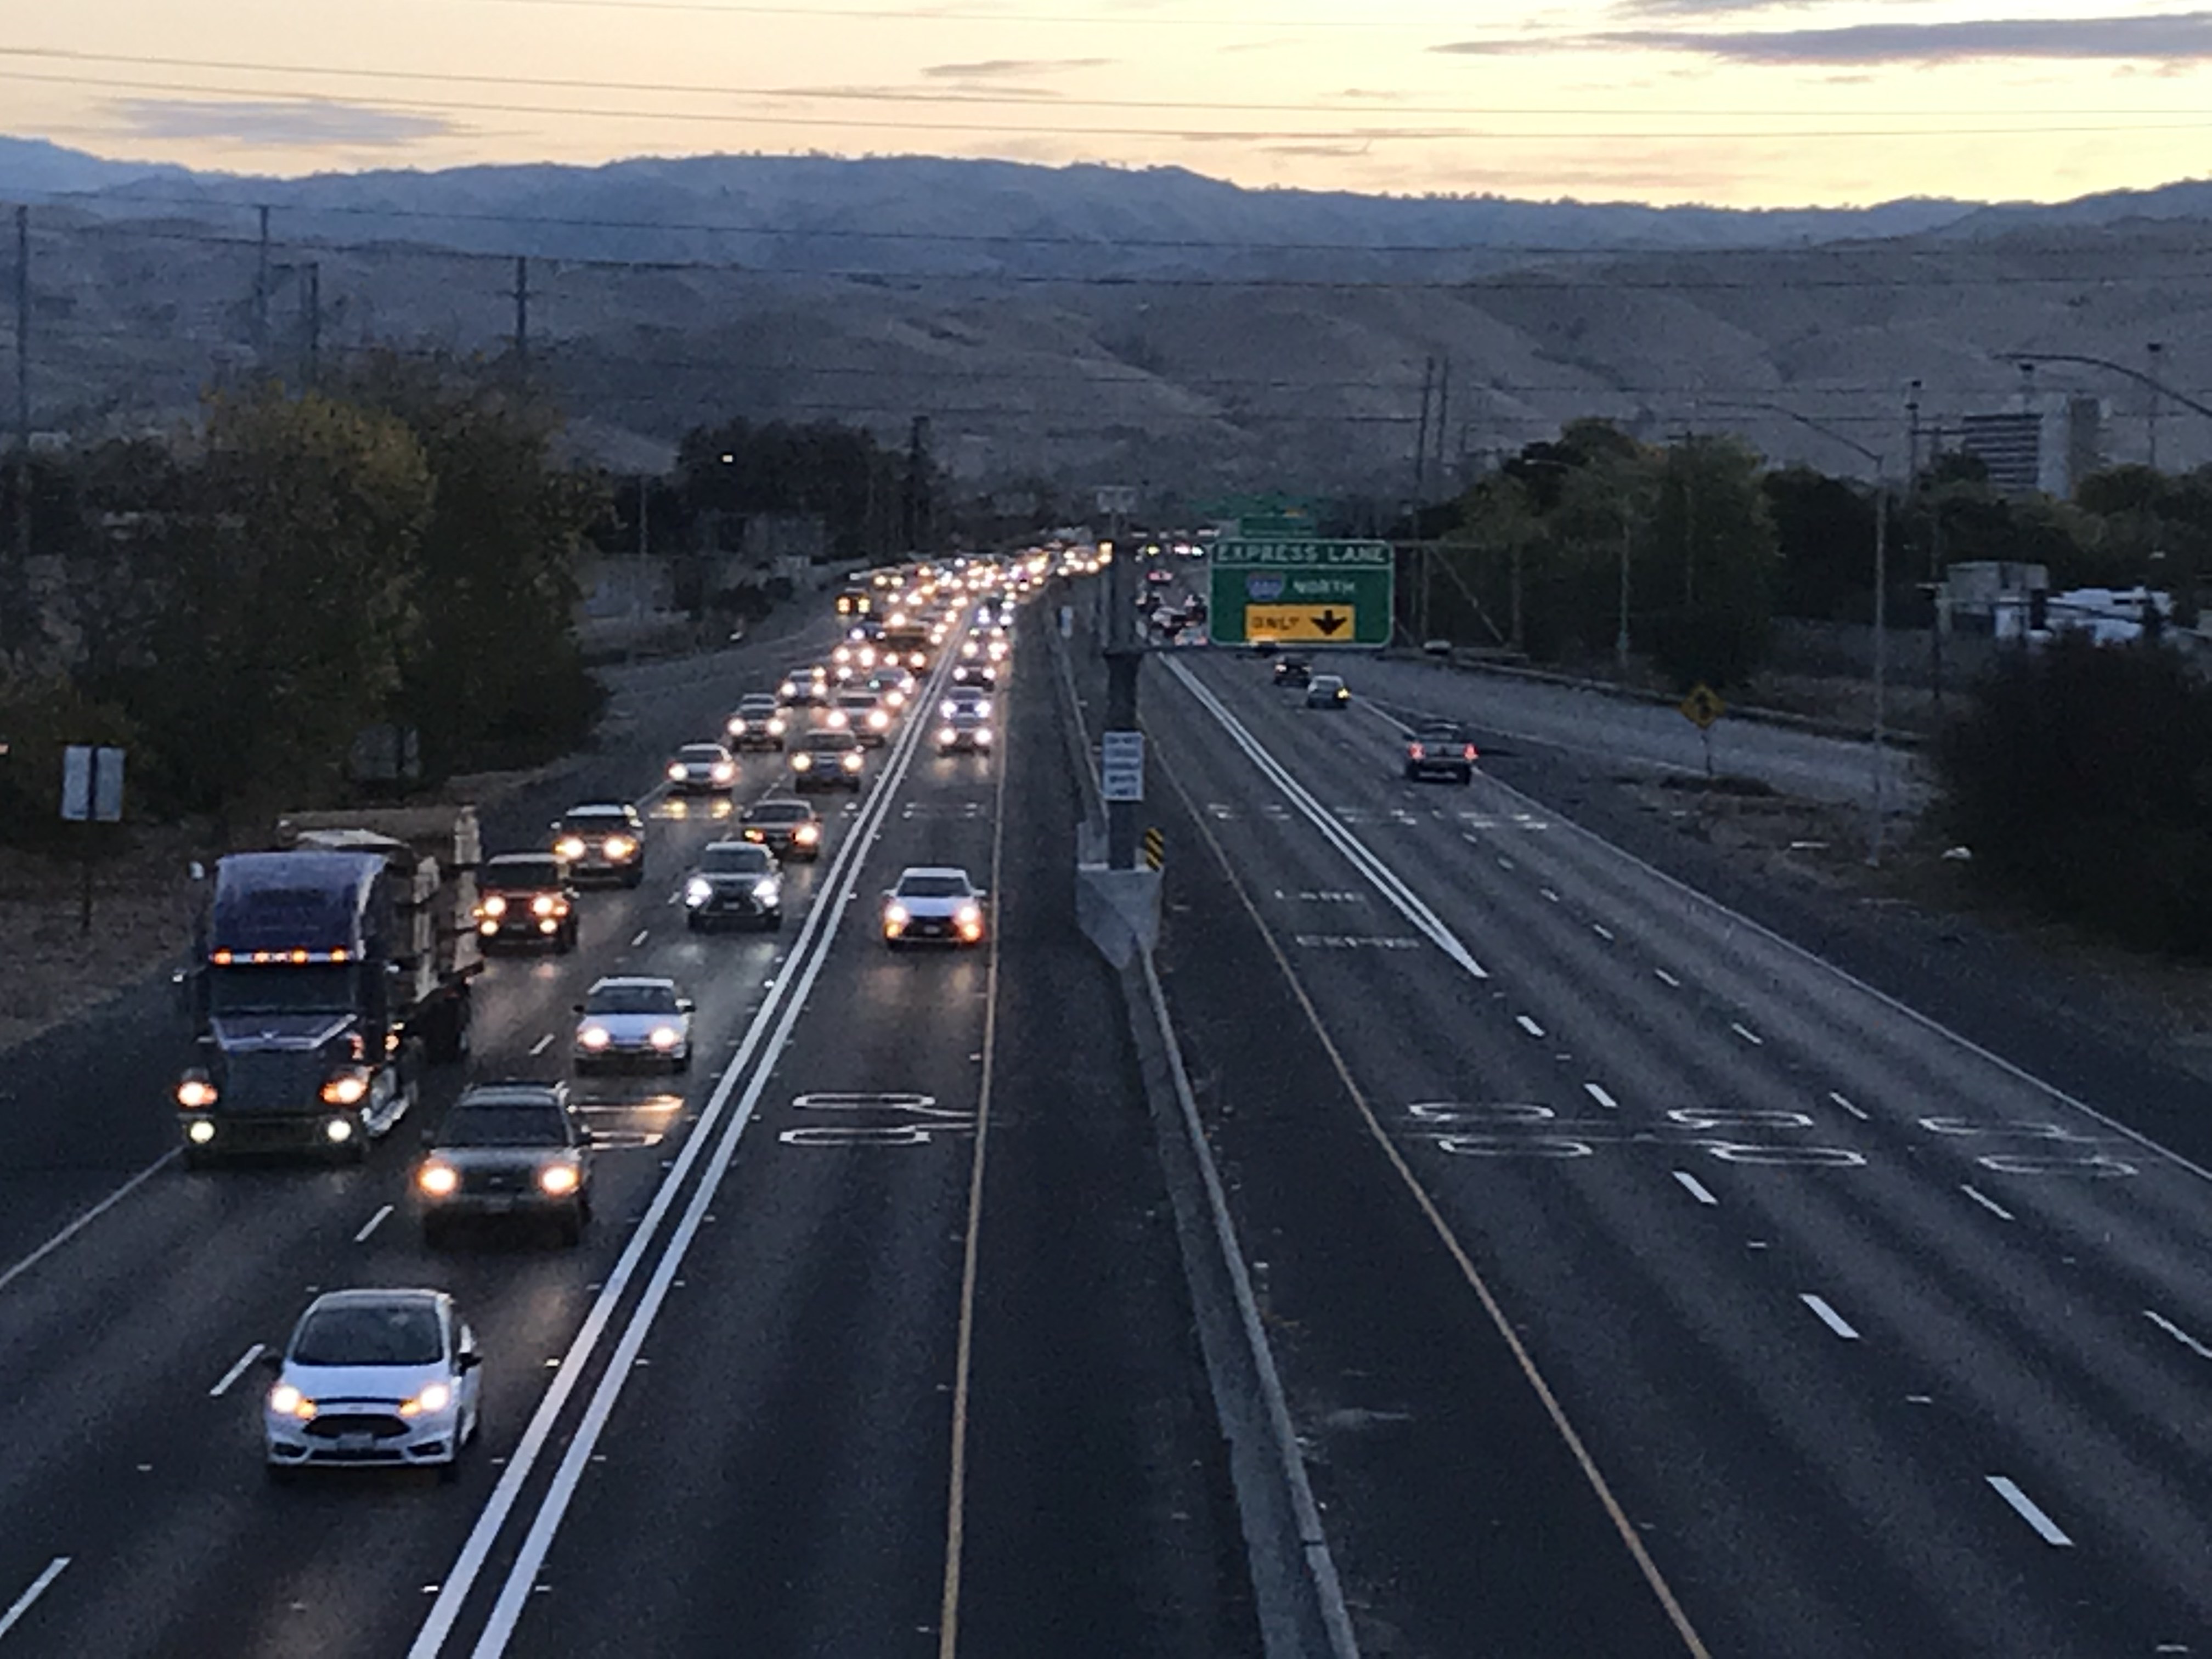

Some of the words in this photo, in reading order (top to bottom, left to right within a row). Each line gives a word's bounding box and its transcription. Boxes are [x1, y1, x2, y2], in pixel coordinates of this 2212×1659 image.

[1217, 544, 1318, 562] EXPRESS
[1328, 546, 1385, 562] LANE
[1293, 579, 1356, 594] NORTH
[1252, 616, 1300, 630] ONLY
